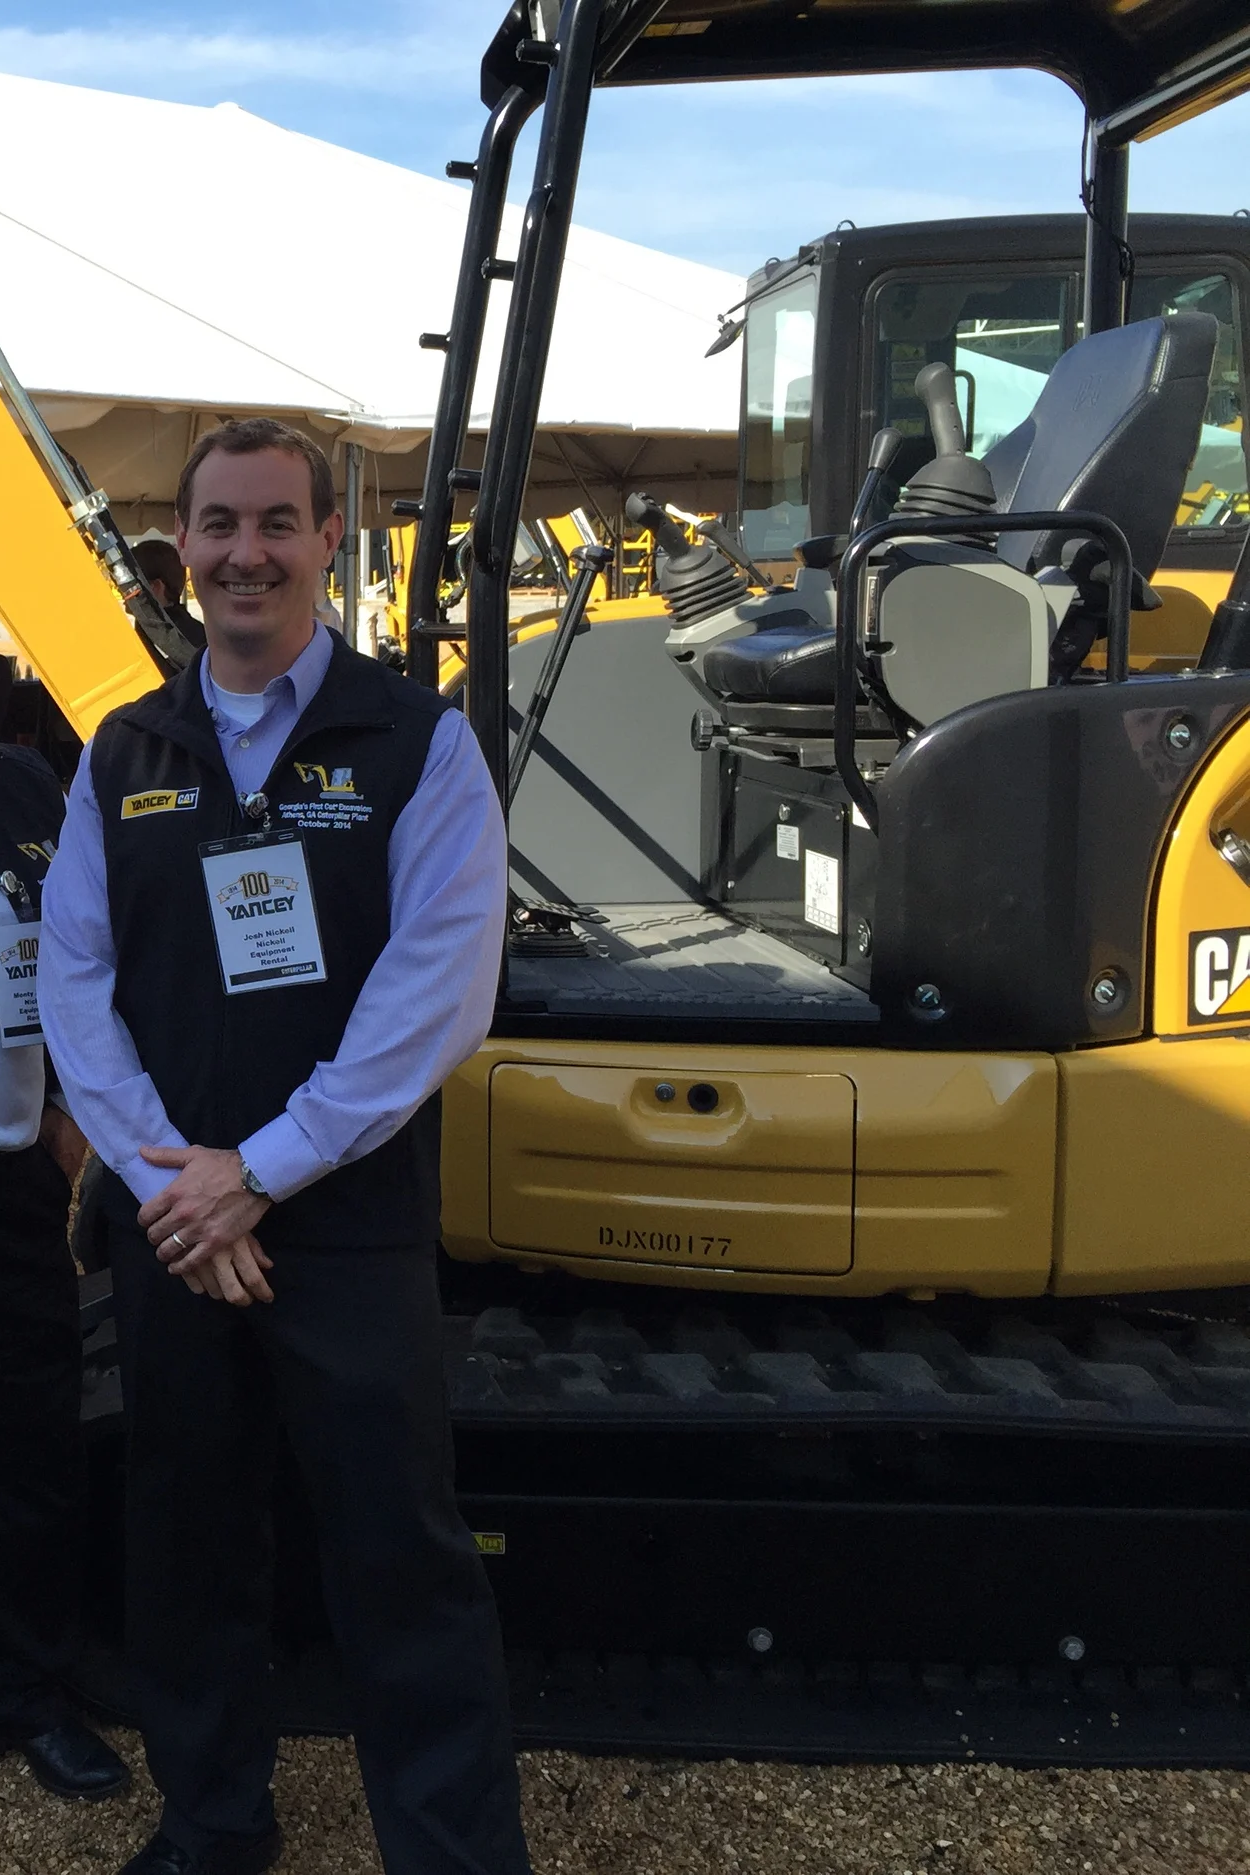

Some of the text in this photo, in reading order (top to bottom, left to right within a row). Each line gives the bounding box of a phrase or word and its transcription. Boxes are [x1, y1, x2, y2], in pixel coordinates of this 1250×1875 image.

[131, 793, 196, 811] YANCEY CAT
[306, 811, 316, 819] GA
[297, 820, 352, 829] October 2014
[240, 872, 270, 898] 100
[225, 895, 295, 921] YANCEY
[243, 926, 295, 941] Josh Nickell
[256, 937, 286, 949] Nickell
[250, 945, 295, 959] Equipment
[260, 955, 288, 966] Rental
[599, 1226, 732, 1256] DJX00177
